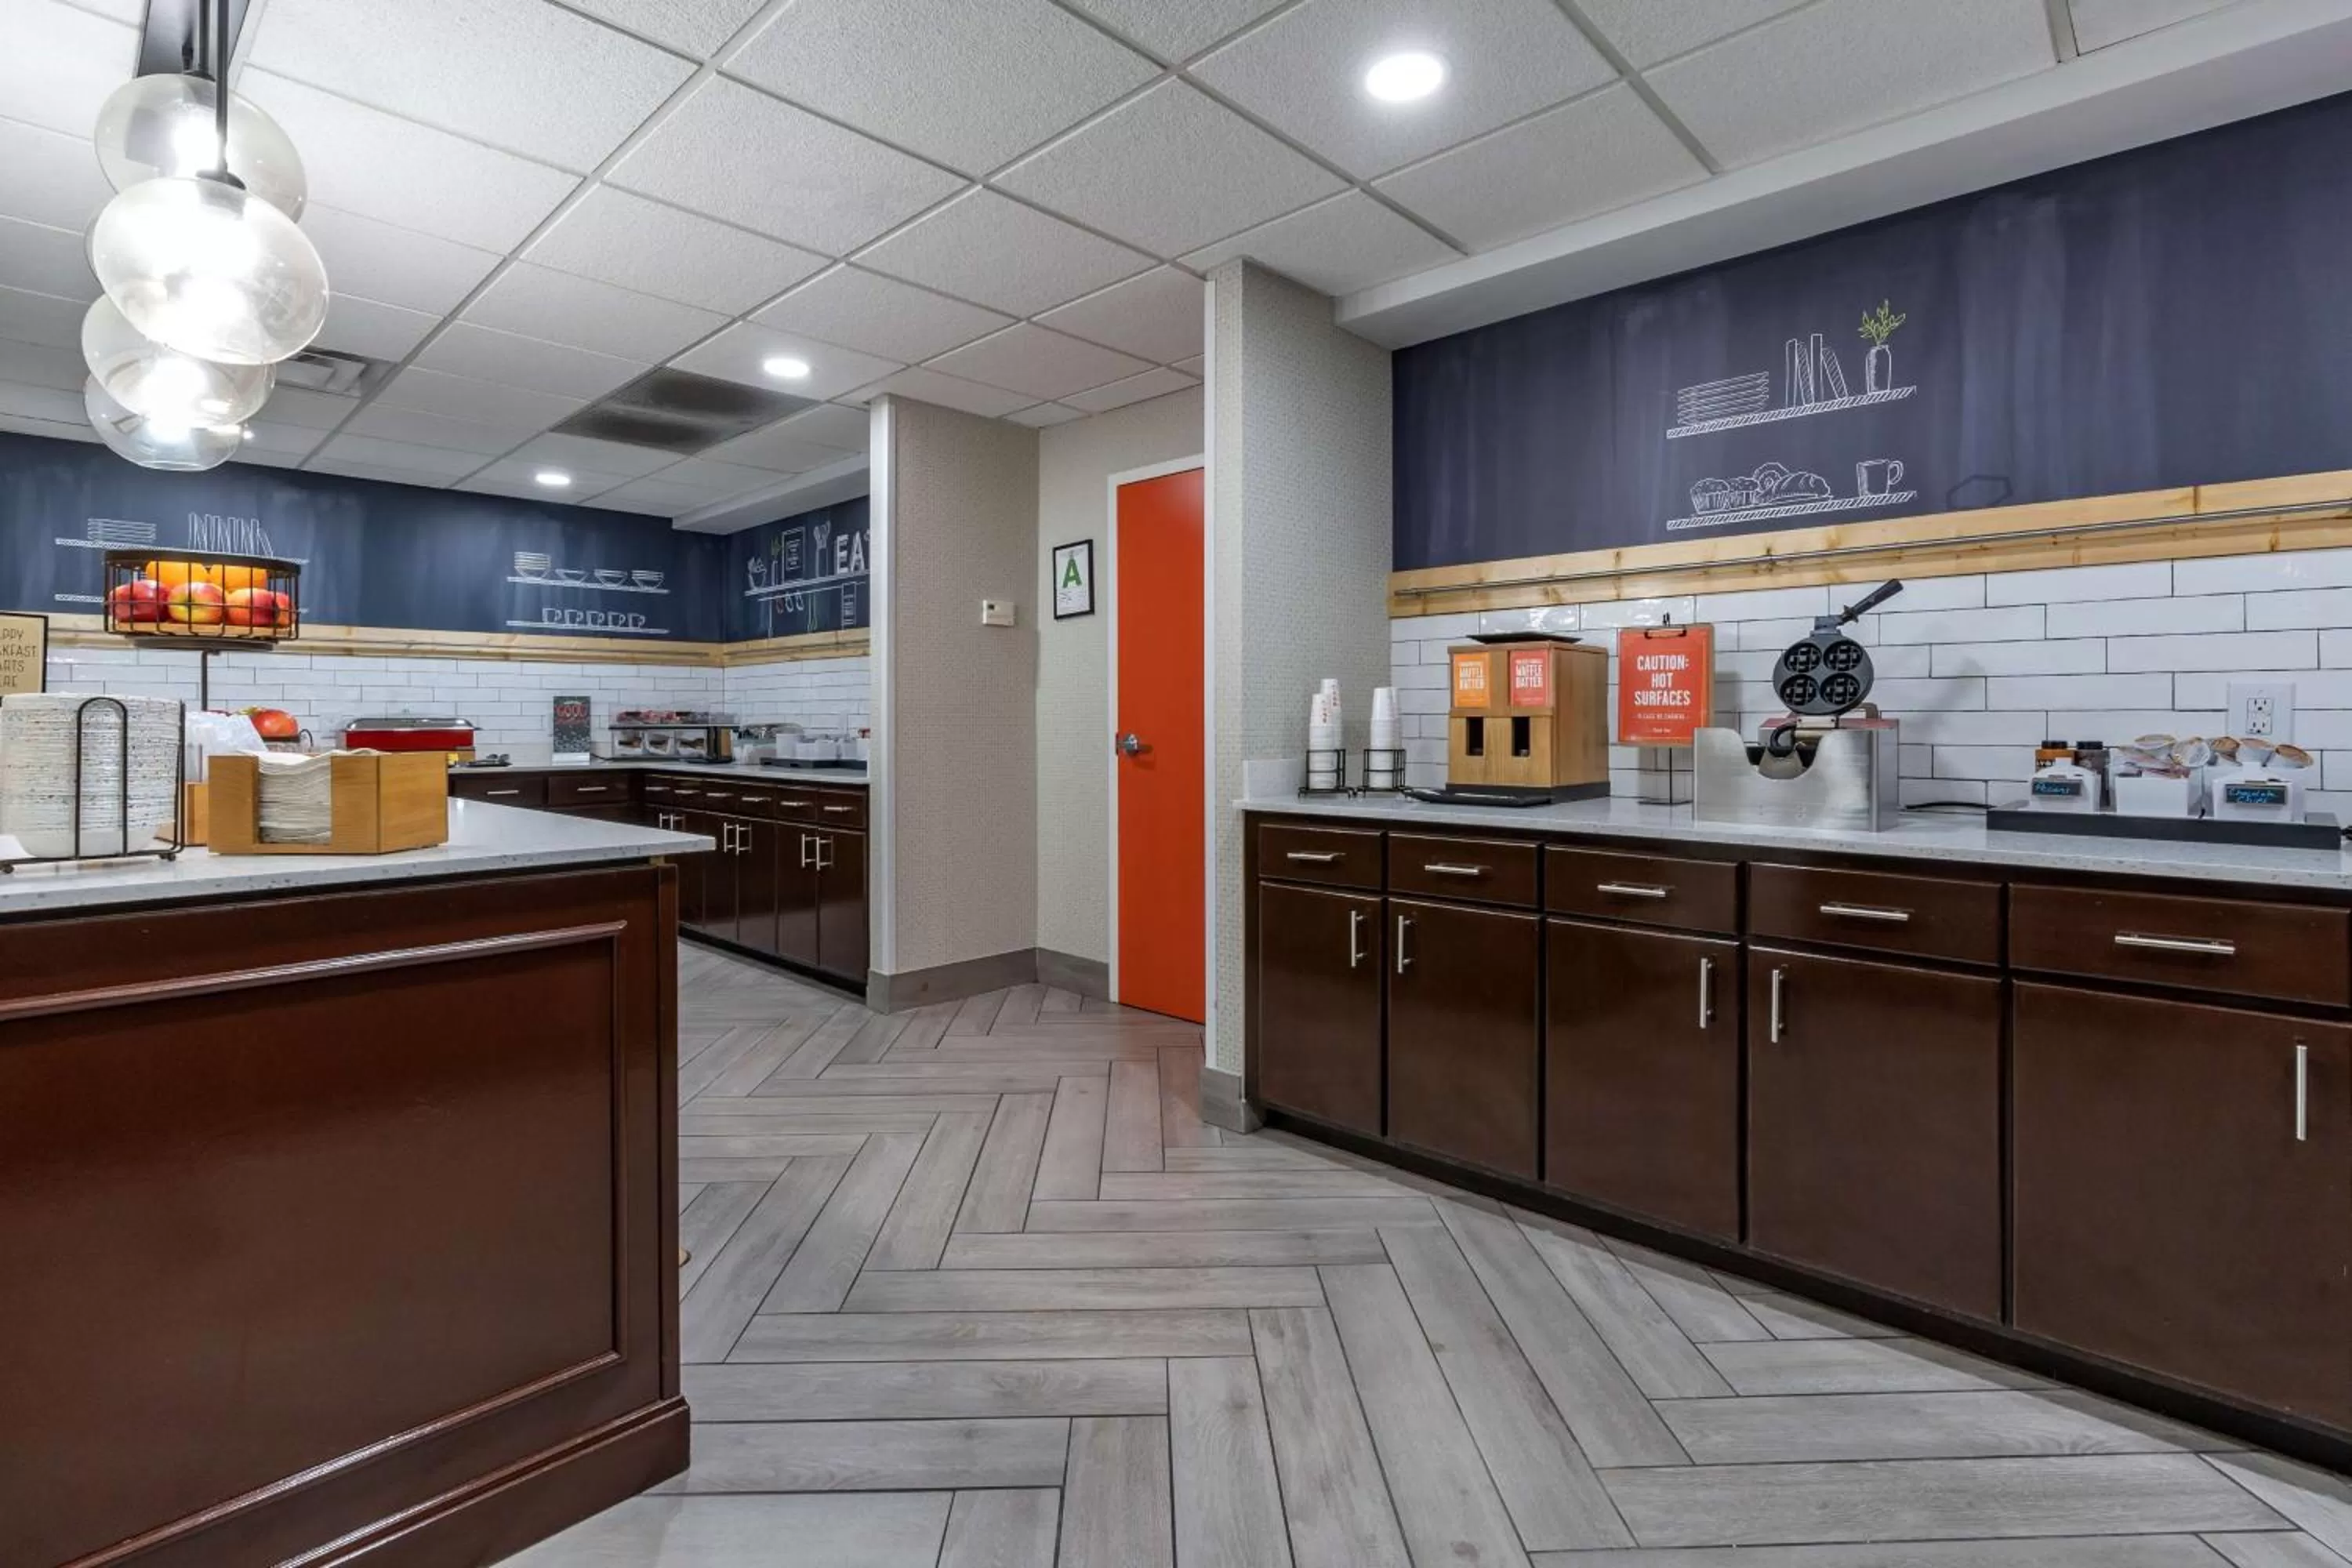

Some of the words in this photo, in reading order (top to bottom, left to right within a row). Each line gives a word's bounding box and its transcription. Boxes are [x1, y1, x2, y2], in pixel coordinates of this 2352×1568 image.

[1062, 557, 1083, 588] A
[0, 628, 24, 641] PPY
[1515, 664, 1543, 677] WAFFLE
[1637, 655, 1690, 671] CAUTION:
[1651, 673, 1674, 688] HOT
[1633, 690, 1691, 706] SURFACES
